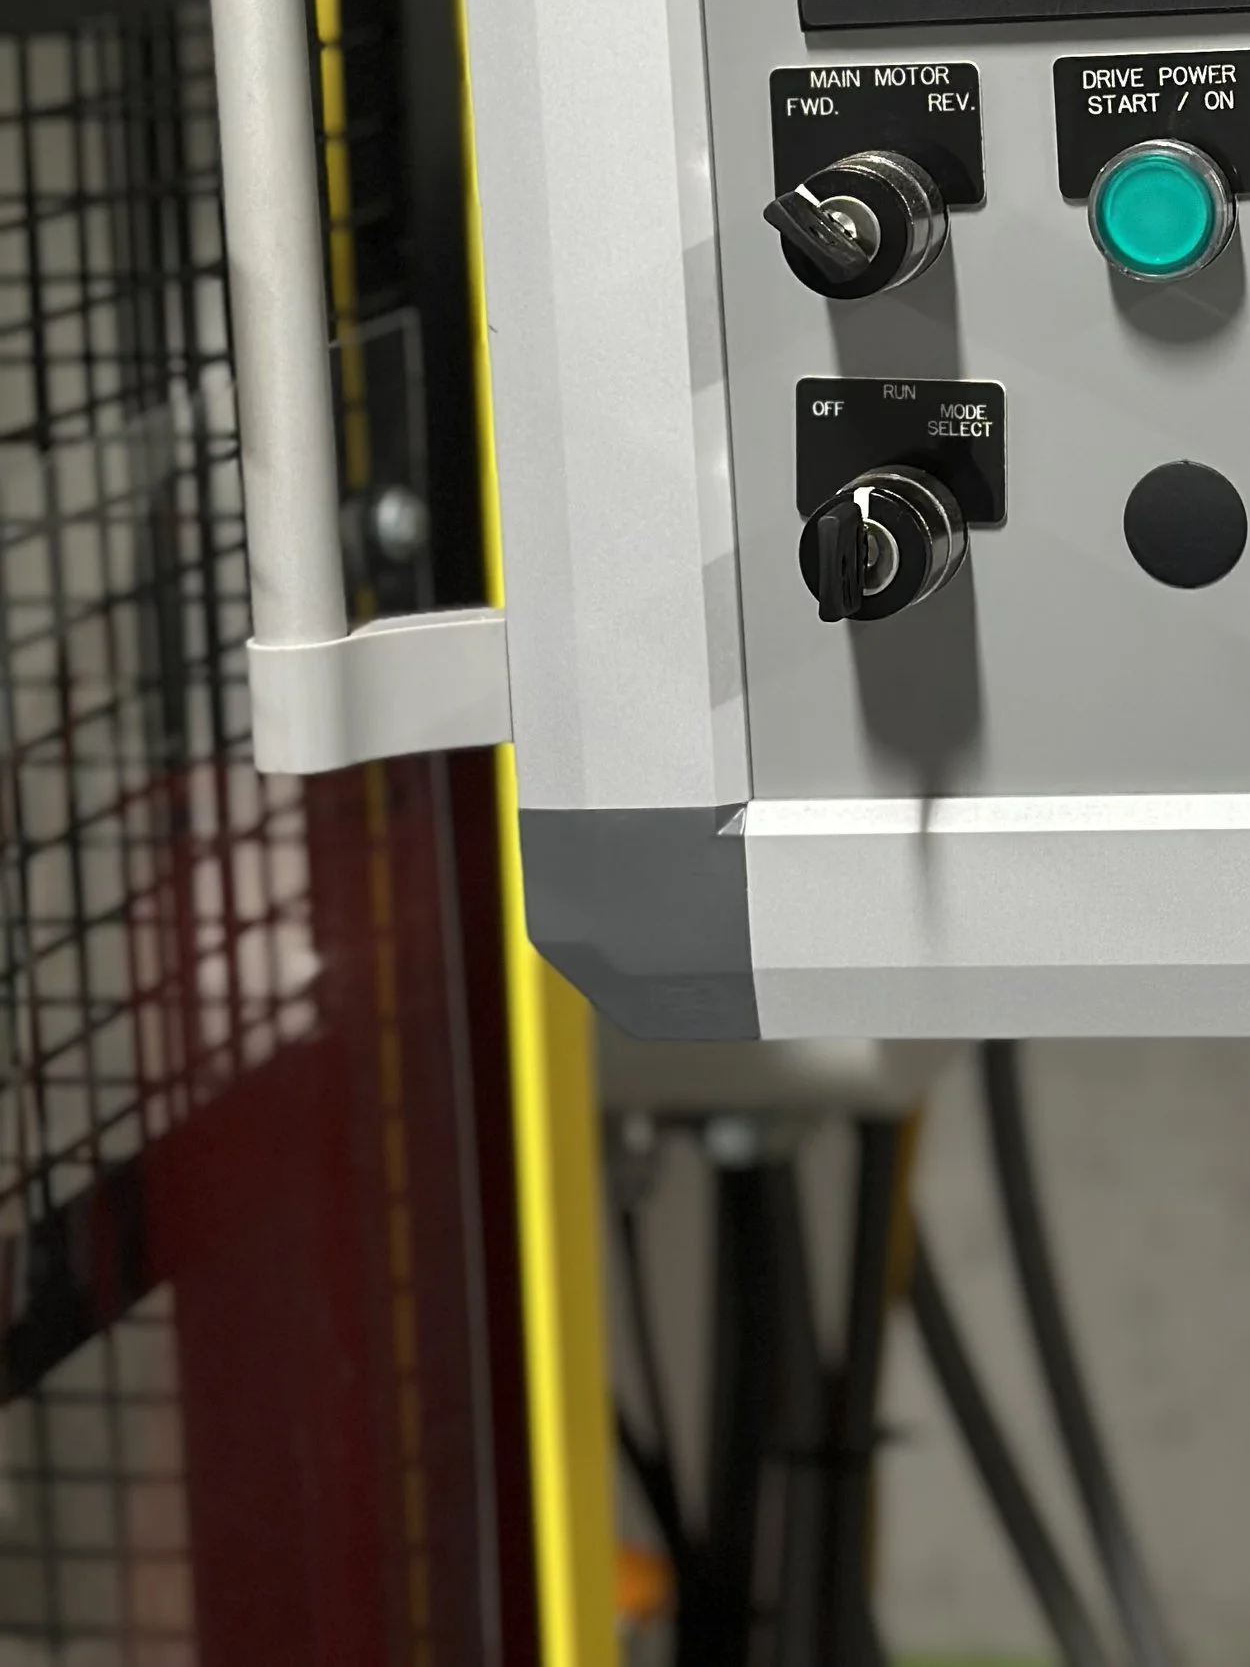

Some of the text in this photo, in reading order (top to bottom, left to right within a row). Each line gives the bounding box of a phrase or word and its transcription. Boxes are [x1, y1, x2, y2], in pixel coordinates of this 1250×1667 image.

[810, 66, 950, 88] MAIN MOTOR
[1082, 64, 1236, 89] DRIVE POWER
[787, 97, 839, 116] FWD.
[928, 92, 976, 112] REV.
[1088, 90, 1235, 115] START / ON
[883, 384, 916, 400] RUN
[812, 401, 845, 417] OFF
[940, 404, 988, 420] MODE
[927, 421, 993, 437] SELECT
